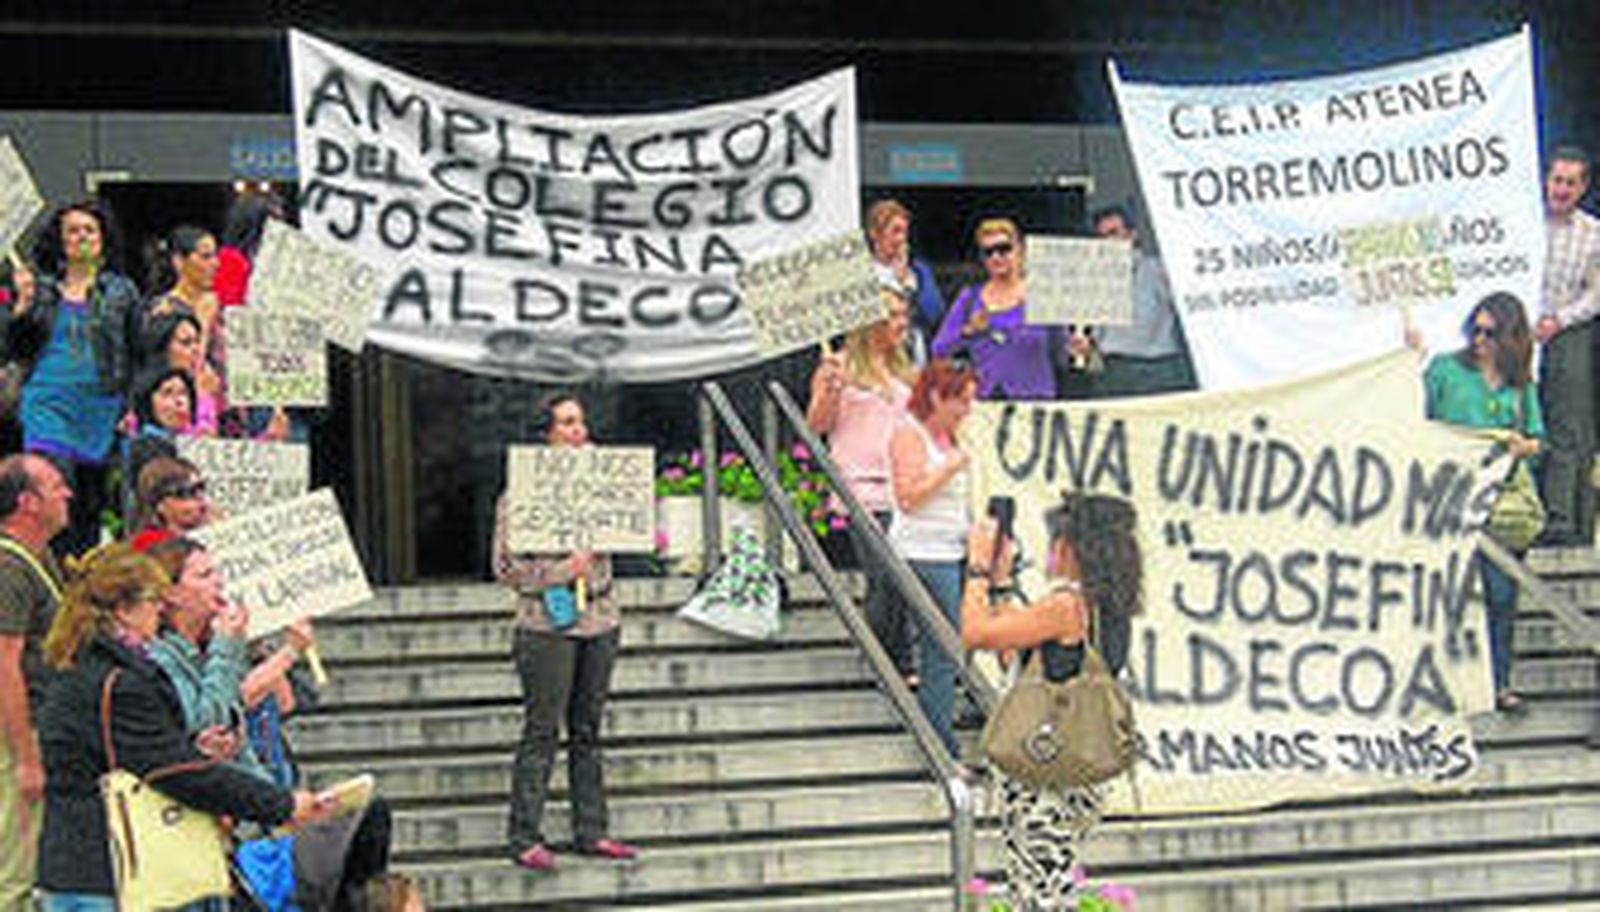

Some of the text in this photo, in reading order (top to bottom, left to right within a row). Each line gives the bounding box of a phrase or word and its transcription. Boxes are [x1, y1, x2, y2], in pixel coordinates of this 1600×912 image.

[306, 66, 837, 180] AMPLIACIÓN
[1325, 69, 1487, 124] ATENEA
[316, 140, 423, 187] DEL
[430, 159, 813, 230] COLEGIO
[1161, 136, 1510, 210] TORREMOLINOS
[996, 405, 1133, 497] UNA
[1156, 416, 1396, 525] UNIDAD
[1338, 725, 1474, 782] JUNTOS
